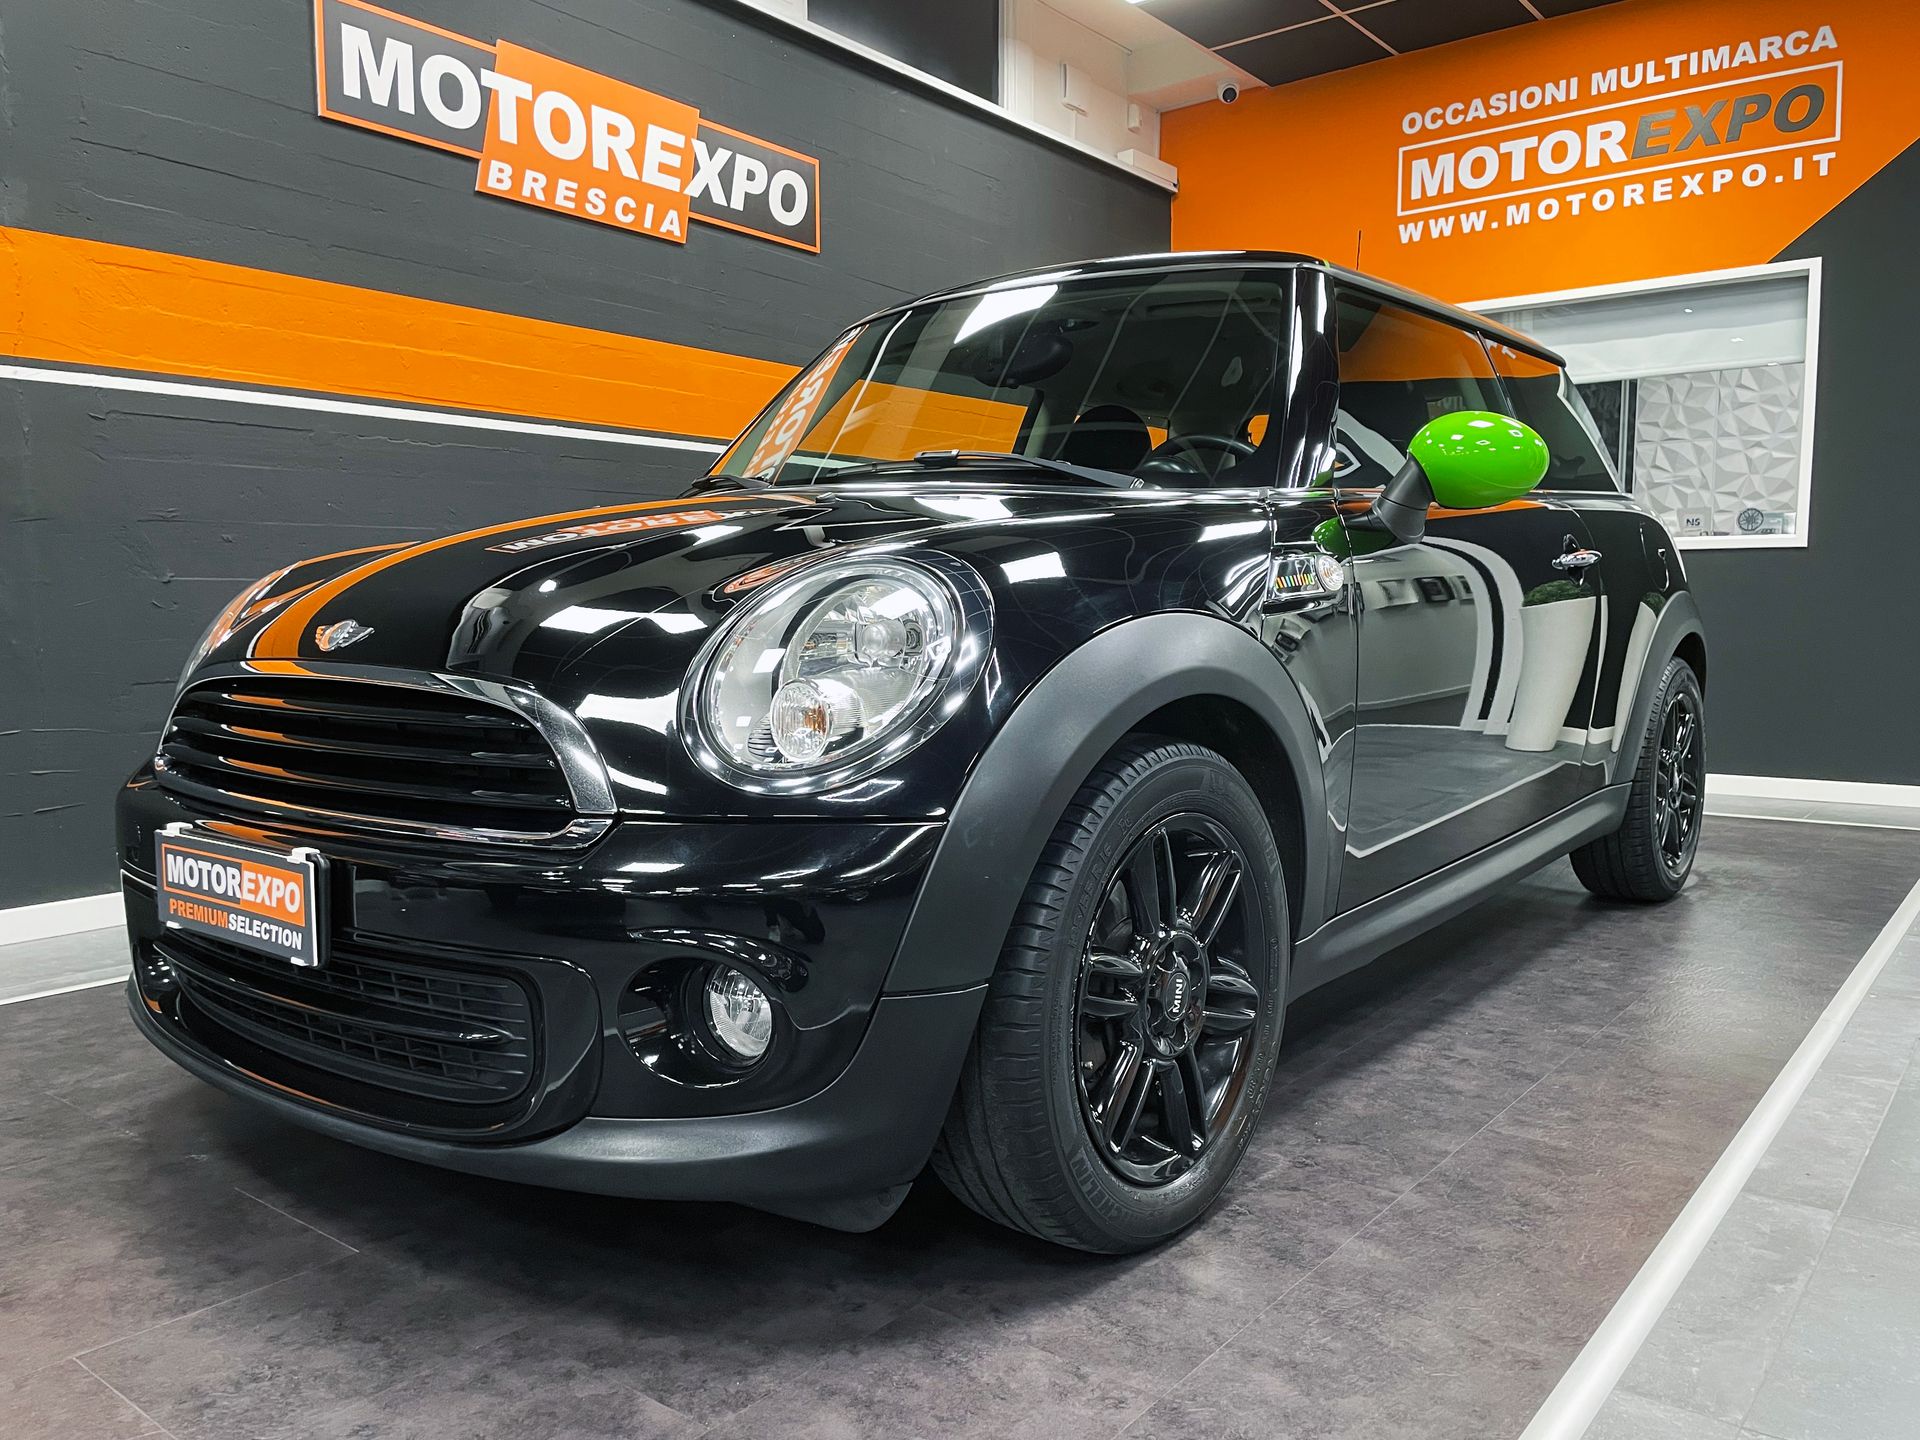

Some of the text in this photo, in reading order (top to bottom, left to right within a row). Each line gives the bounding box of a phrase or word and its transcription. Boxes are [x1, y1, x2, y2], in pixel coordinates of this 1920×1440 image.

[341, 22, 809, 227] MOTOREXPO
[1402, 25, 1838, 135] OCCASIONI MULTIMARCA
[1410, 84, 1826, 201] MOTOREXPO
[486, 160, 682, 238] BRESCIA
[1398, 152, 1837, 245] WWW.MOTOREXPO.IT
[166, 853, 301, 914] MOTOREXPO
[1172, 978, 1183, 1013] MINI
